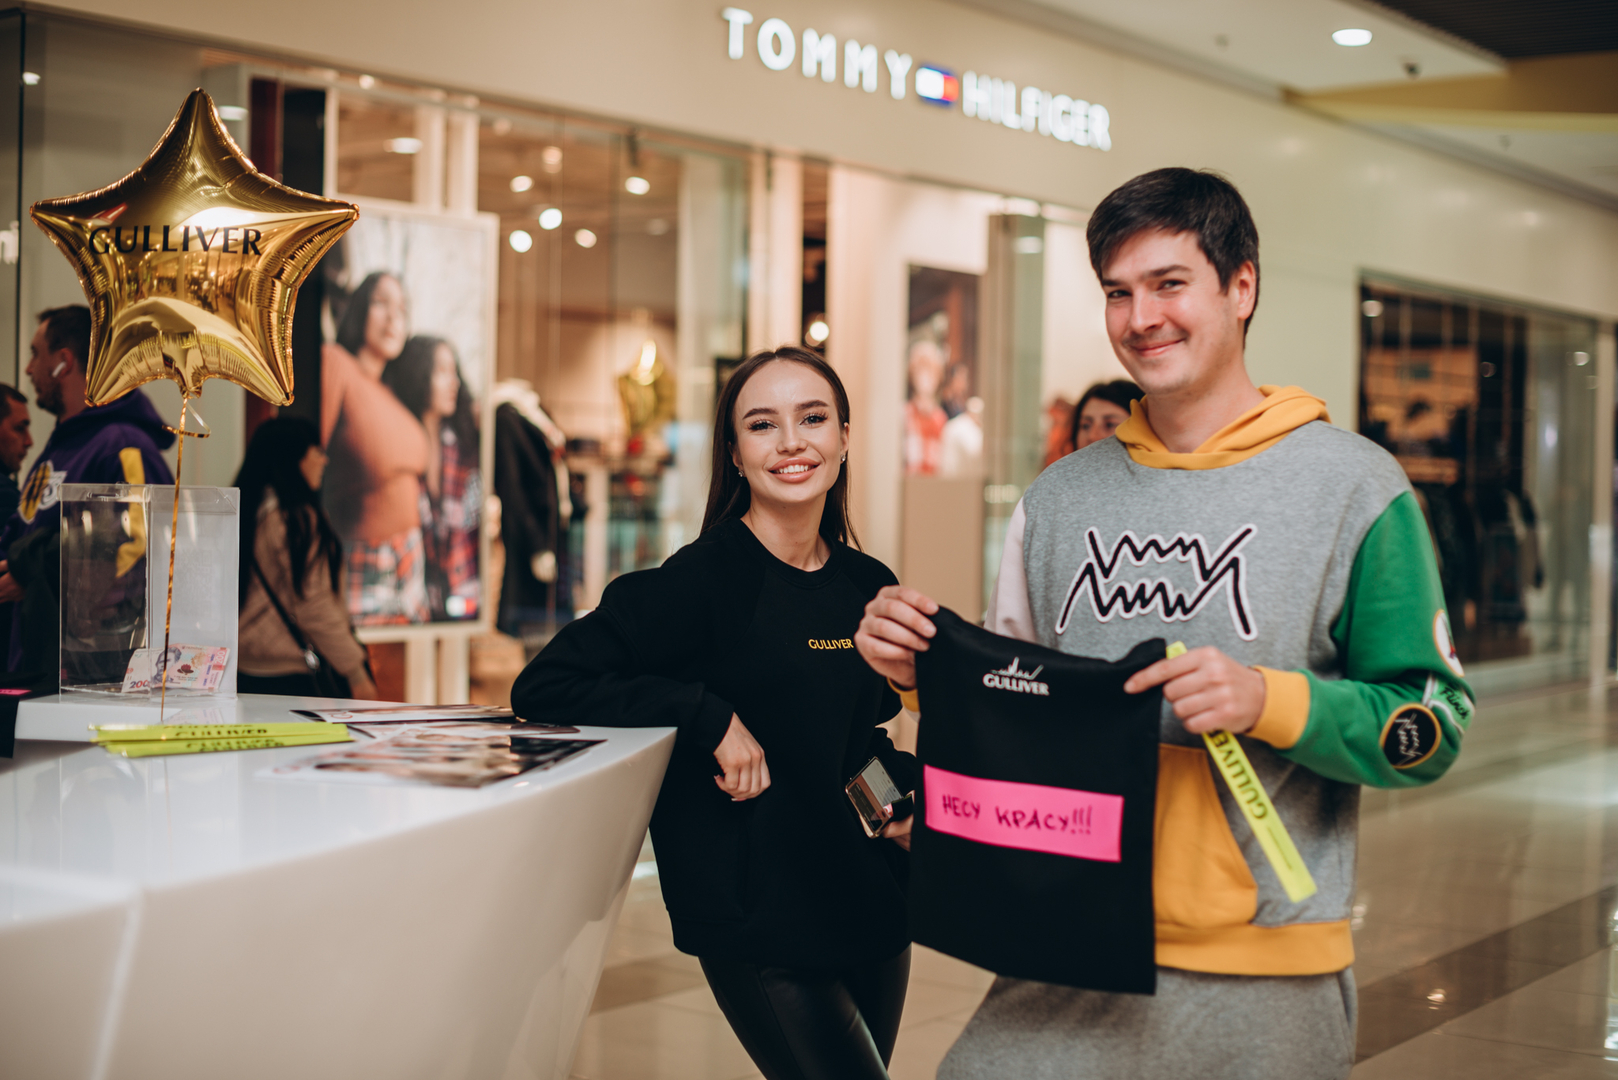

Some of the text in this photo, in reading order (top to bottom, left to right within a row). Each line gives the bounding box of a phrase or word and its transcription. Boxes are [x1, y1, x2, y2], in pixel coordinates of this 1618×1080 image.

[721, 7, 1112, 152] TOMMY HILFIGER
[88, 224, 262, 256] GULLIVER
[808, 638, 854, 650] GULLIVER
[982, 673, 1050, 697] GULLIVER
